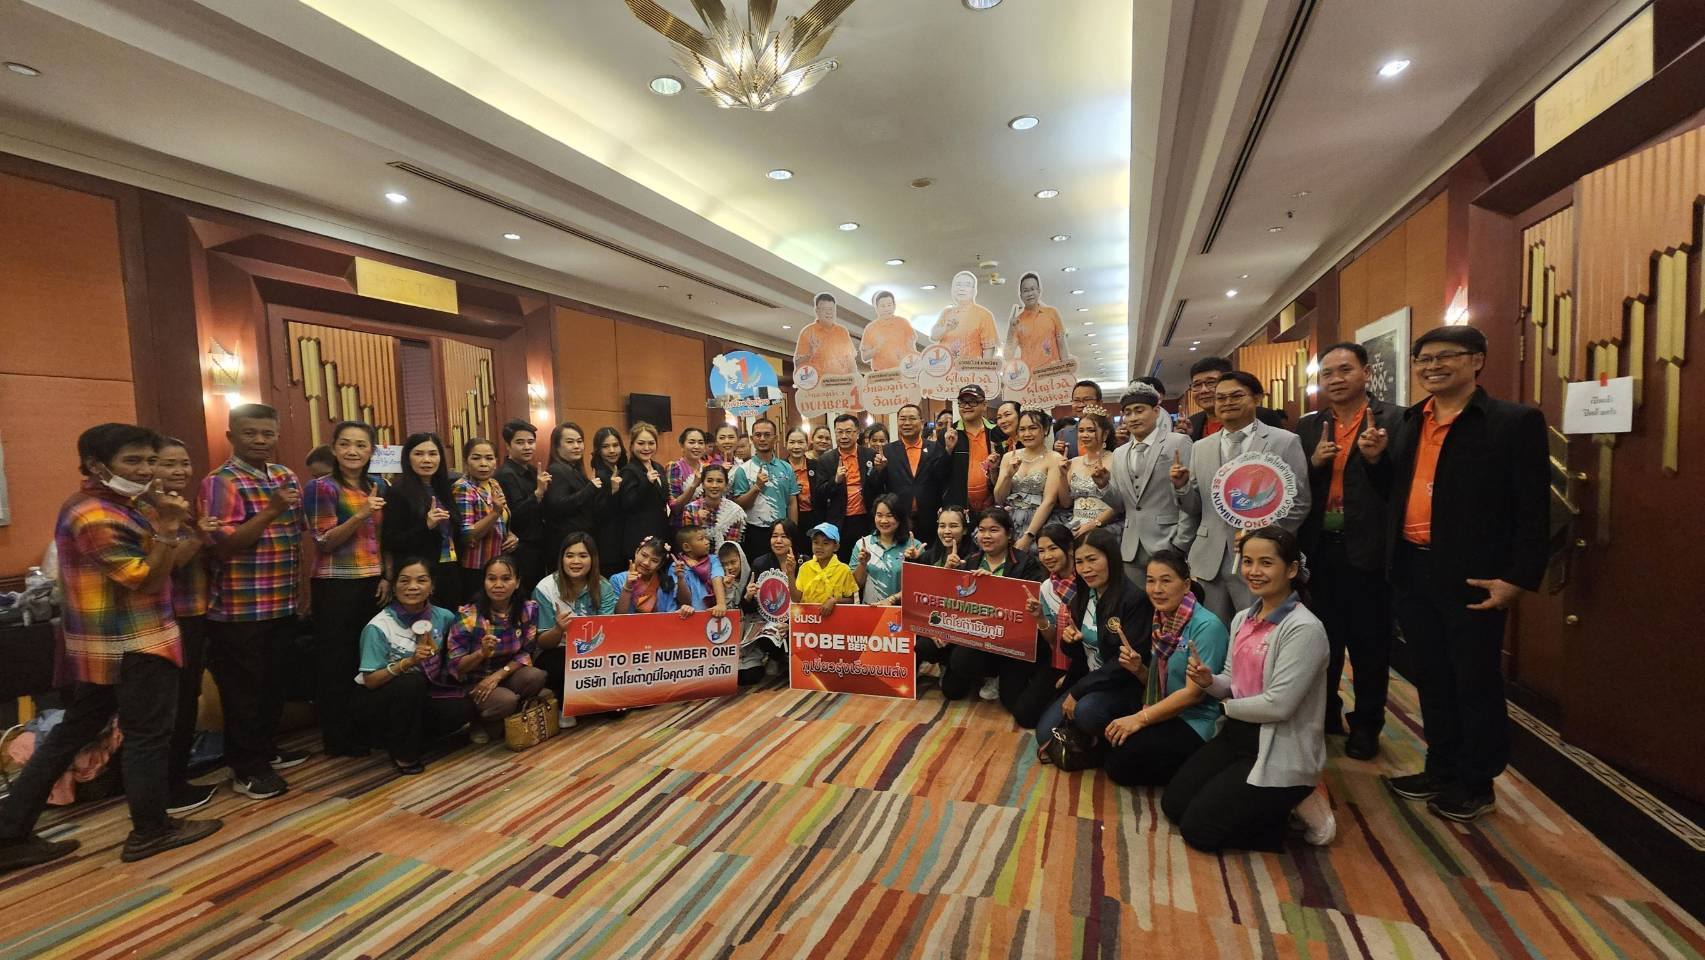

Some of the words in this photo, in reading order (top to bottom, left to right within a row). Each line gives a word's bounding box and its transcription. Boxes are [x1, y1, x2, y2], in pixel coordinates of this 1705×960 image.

[1212, 492, 1242, 526] NUMBER
[1244, 520, 1268, 528] ONE
[868, 636, 911, 654] ONE
[571, 657, 603, 670] ชมรม
[608, 655, 627, 667] TO
[632, 653, 650, 664] BE
[655, 649, 707, 662] NUMBER
[712, 646, 736, 657] ONE
[576, 675, 606, 690] บริษัท
[708, 663, 731, 676] จำกัด
